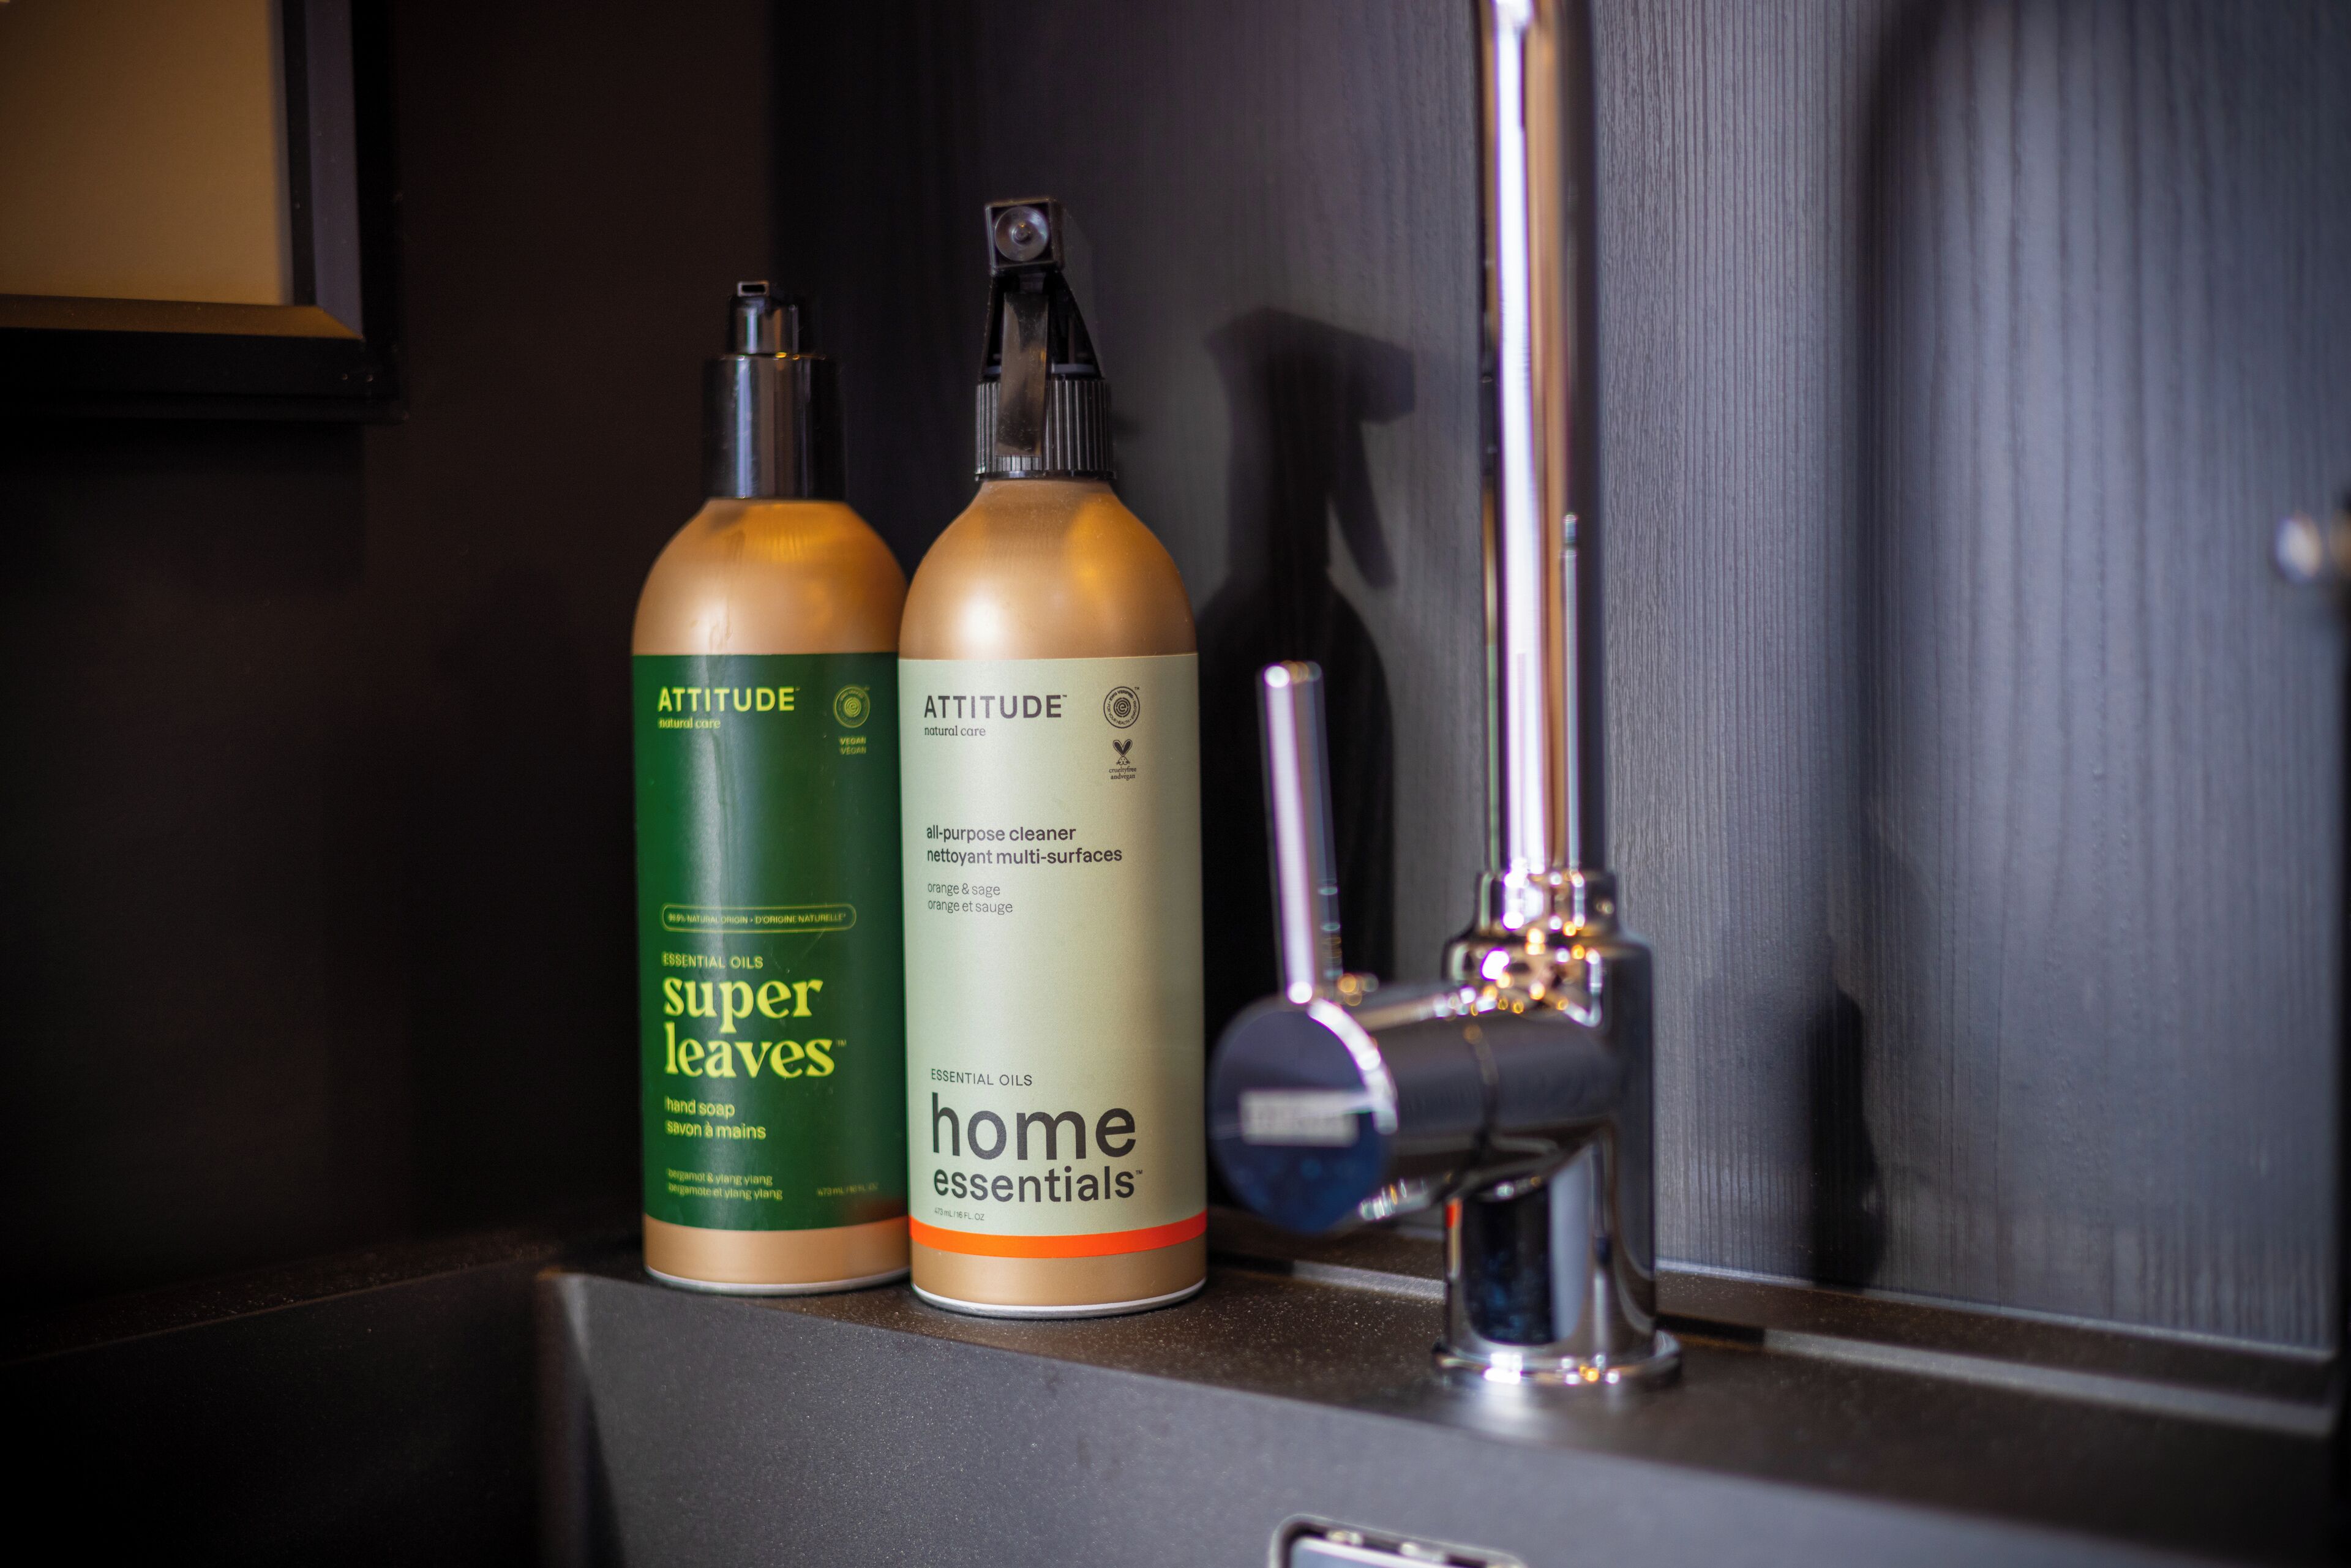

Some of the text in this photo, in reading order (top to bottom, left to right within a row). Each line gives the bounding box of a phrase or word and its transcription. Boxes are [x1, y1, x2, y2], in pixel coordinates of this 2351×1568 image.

[658, 686, 795, 712] ATTITUDE
[659, 718, 721, 729] natural care
[924, 726, 986, 737] natural care
[926, 825, 1076, 844] all-purpose cleaner
[927, 847, 1123, 866] nettoyant multi-surfaces
[928, 883, 1001, 898] orange & sage
[928, 900, 1013, 915] orange et sauge
[687, 915, 719, 923] NATURAL
[662, 951, 763, 969] ESSENTIAL OILS
[663, 977, 823, 1033] super
[931, 1068, 1033, 1086] ESSENTIAL OILS
[665, 1097, 735, 1119] hand soap
[666, 1120, 766, 1139] savon à mains
[932, 1092, 1136, 1160] home
[668, 1168, 705, 1182] bergamot
[716, 1173, 742, 1186] ylang
[744, 1175, 773, 1187] ylang
[669, 1183, 783, 1201] bergamote et ylang ylang
